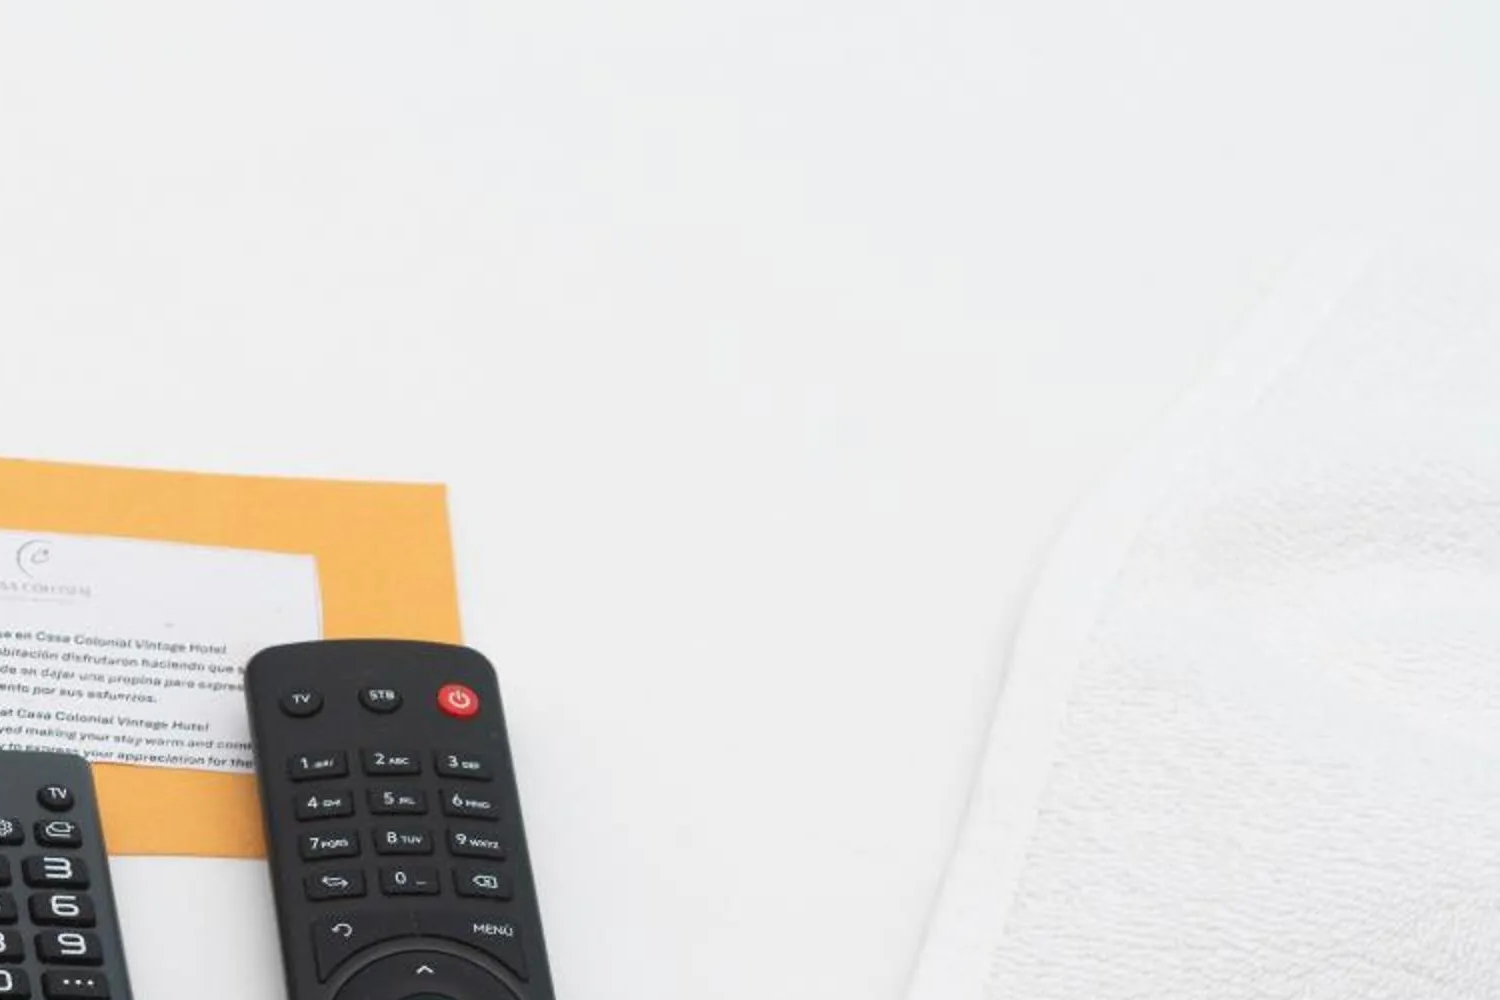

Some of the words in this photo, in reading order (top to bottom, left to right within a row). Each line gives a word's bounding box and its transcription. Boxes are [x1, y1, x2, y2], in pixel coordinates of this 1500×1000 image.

[15, 632, 32, 640] en
[36, 631, 69, 644] Casa
[74, 634, 131, 649] Colonial
[135, 639, 186, 654] Vintage
[189, 644, 227, 655] Hotel
[61, 652, 138, 667] disfrutaron
[142, 658, 205, 672] haciendo
[208, 664, 234, 674] que
[21, 667, 37, 676] en
[79, 673, 106, 683] una
[108, 675, 162, 687] propina
[164, 679, 194, 689] para
[33, 687, 56, 696] por
[59, 688, 83, 698] sus
[87, 689, 158, 704] esfuerzos.
[291, 693, 312, 704] TV
[368, 688, 395, 701] STB
[0, 707, 14, 717] at
[17, 707, 52, 721] Casa
[55, 711, 113, 726] Colonial
[117, 716, 169, 731] Vintage
[171, 721, 209, 733] Hotel
[25, 727, 77, 742] making
[80, 732, 109, 743] your
[114, 734, 140, 747] stay
[145, 737, 184, 748] warm
[188, 739, 213, 750] and
[9, 741, 23, 751] to
[83, 748, 115, 760] your
[118, 751, 206, 766] appreciation
[208, 755, 227, 767] for
[375, 752, 385, 766] 2
[388, 756, 410, 766] ABC
[447, 754, 458, 768] 3
[300, 757, 309, 770] 1
[48, 786, 68, 799] TV
[383, 791, 393, 805] 5
[306, 795, 318, 809] 4
[451, 793, 463, 807] 6
[309, 837, 319, 849] 7
[386, 831, 397, 844] 8
[401, 835, 423, 846] TUV
[455, 833, 467, 845] 9
[42, 856, 74, 880] 3
[394, 871, 407, 885] 0
[50, 895, 81, 918] 6
[56, 933, 88, 956] 9
